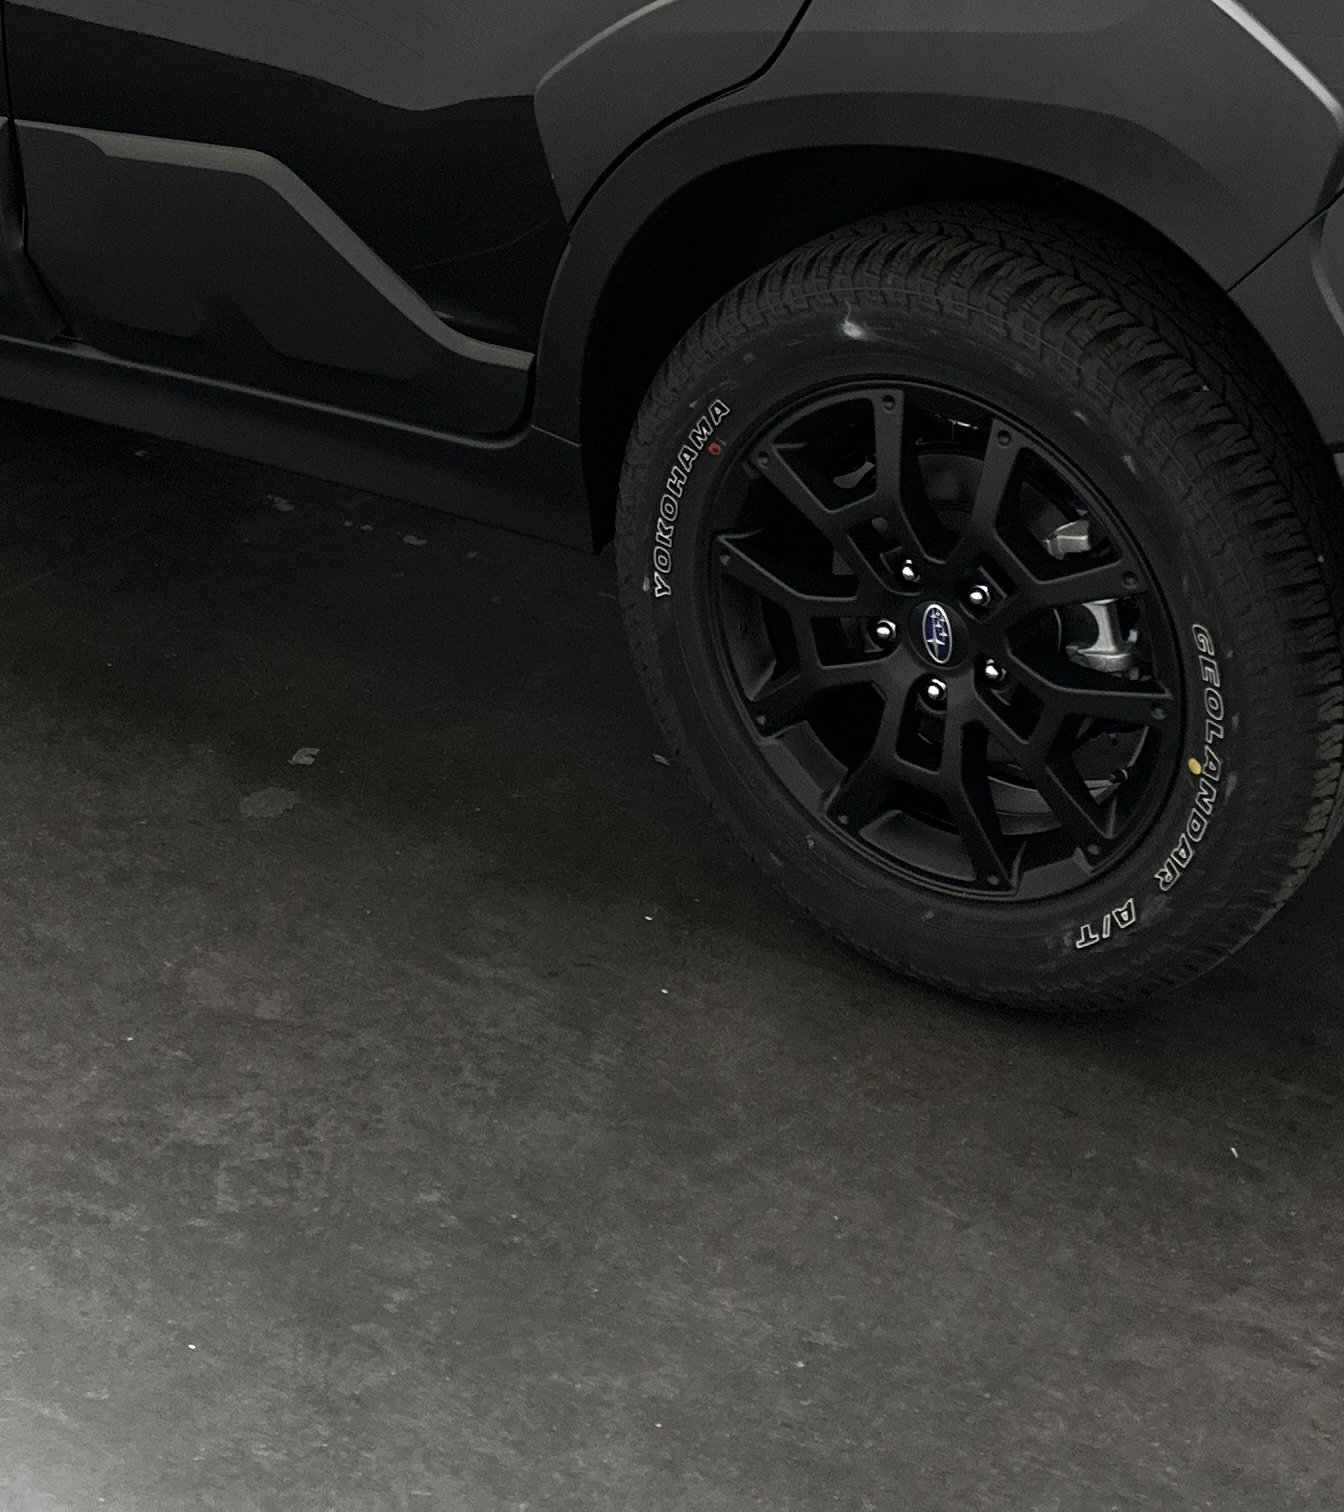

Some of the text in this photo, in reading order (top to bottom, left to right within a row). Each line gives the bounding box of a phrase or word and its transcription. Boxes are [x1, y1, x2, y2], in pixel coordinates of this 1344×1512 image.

[653, 398, 731, 598] YOKOHAMA
[1076, 623, 1225, 949] GEOLANDAR A/T
